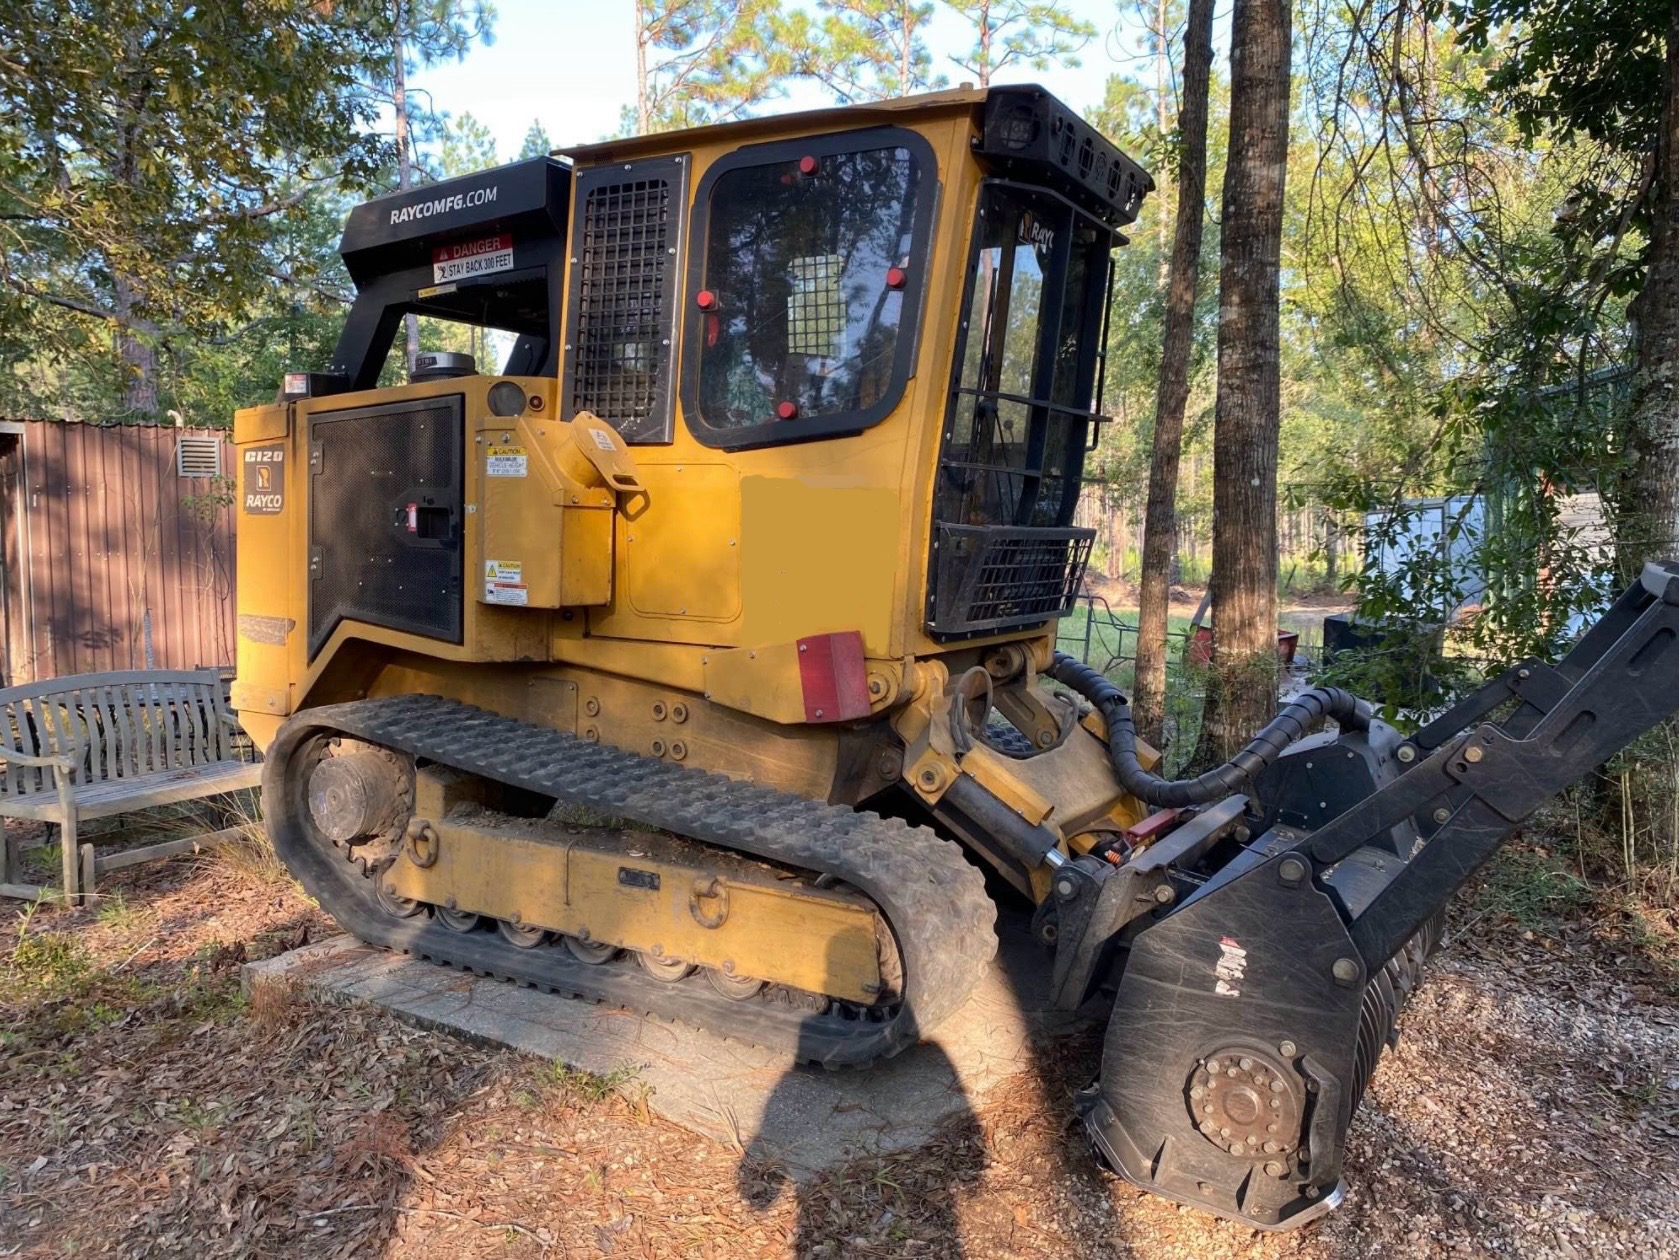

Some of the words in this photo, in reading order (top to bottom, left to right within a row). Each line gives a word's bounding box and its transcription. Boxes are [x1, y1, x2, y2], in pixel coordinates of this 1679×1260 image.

[390, 186, 498, 225] RAYCOMFG.COM
[453, 237, 501, 258] DANGER
[449, 263, 464, 277] STAY
[466, 259, 483, 274] BACK
[484, 256, 495, 269] 300
[495, 253, 511, 268] FEET
[245, 451, 284, 462] C120
[246, 494, 282, 508] RAYCO
